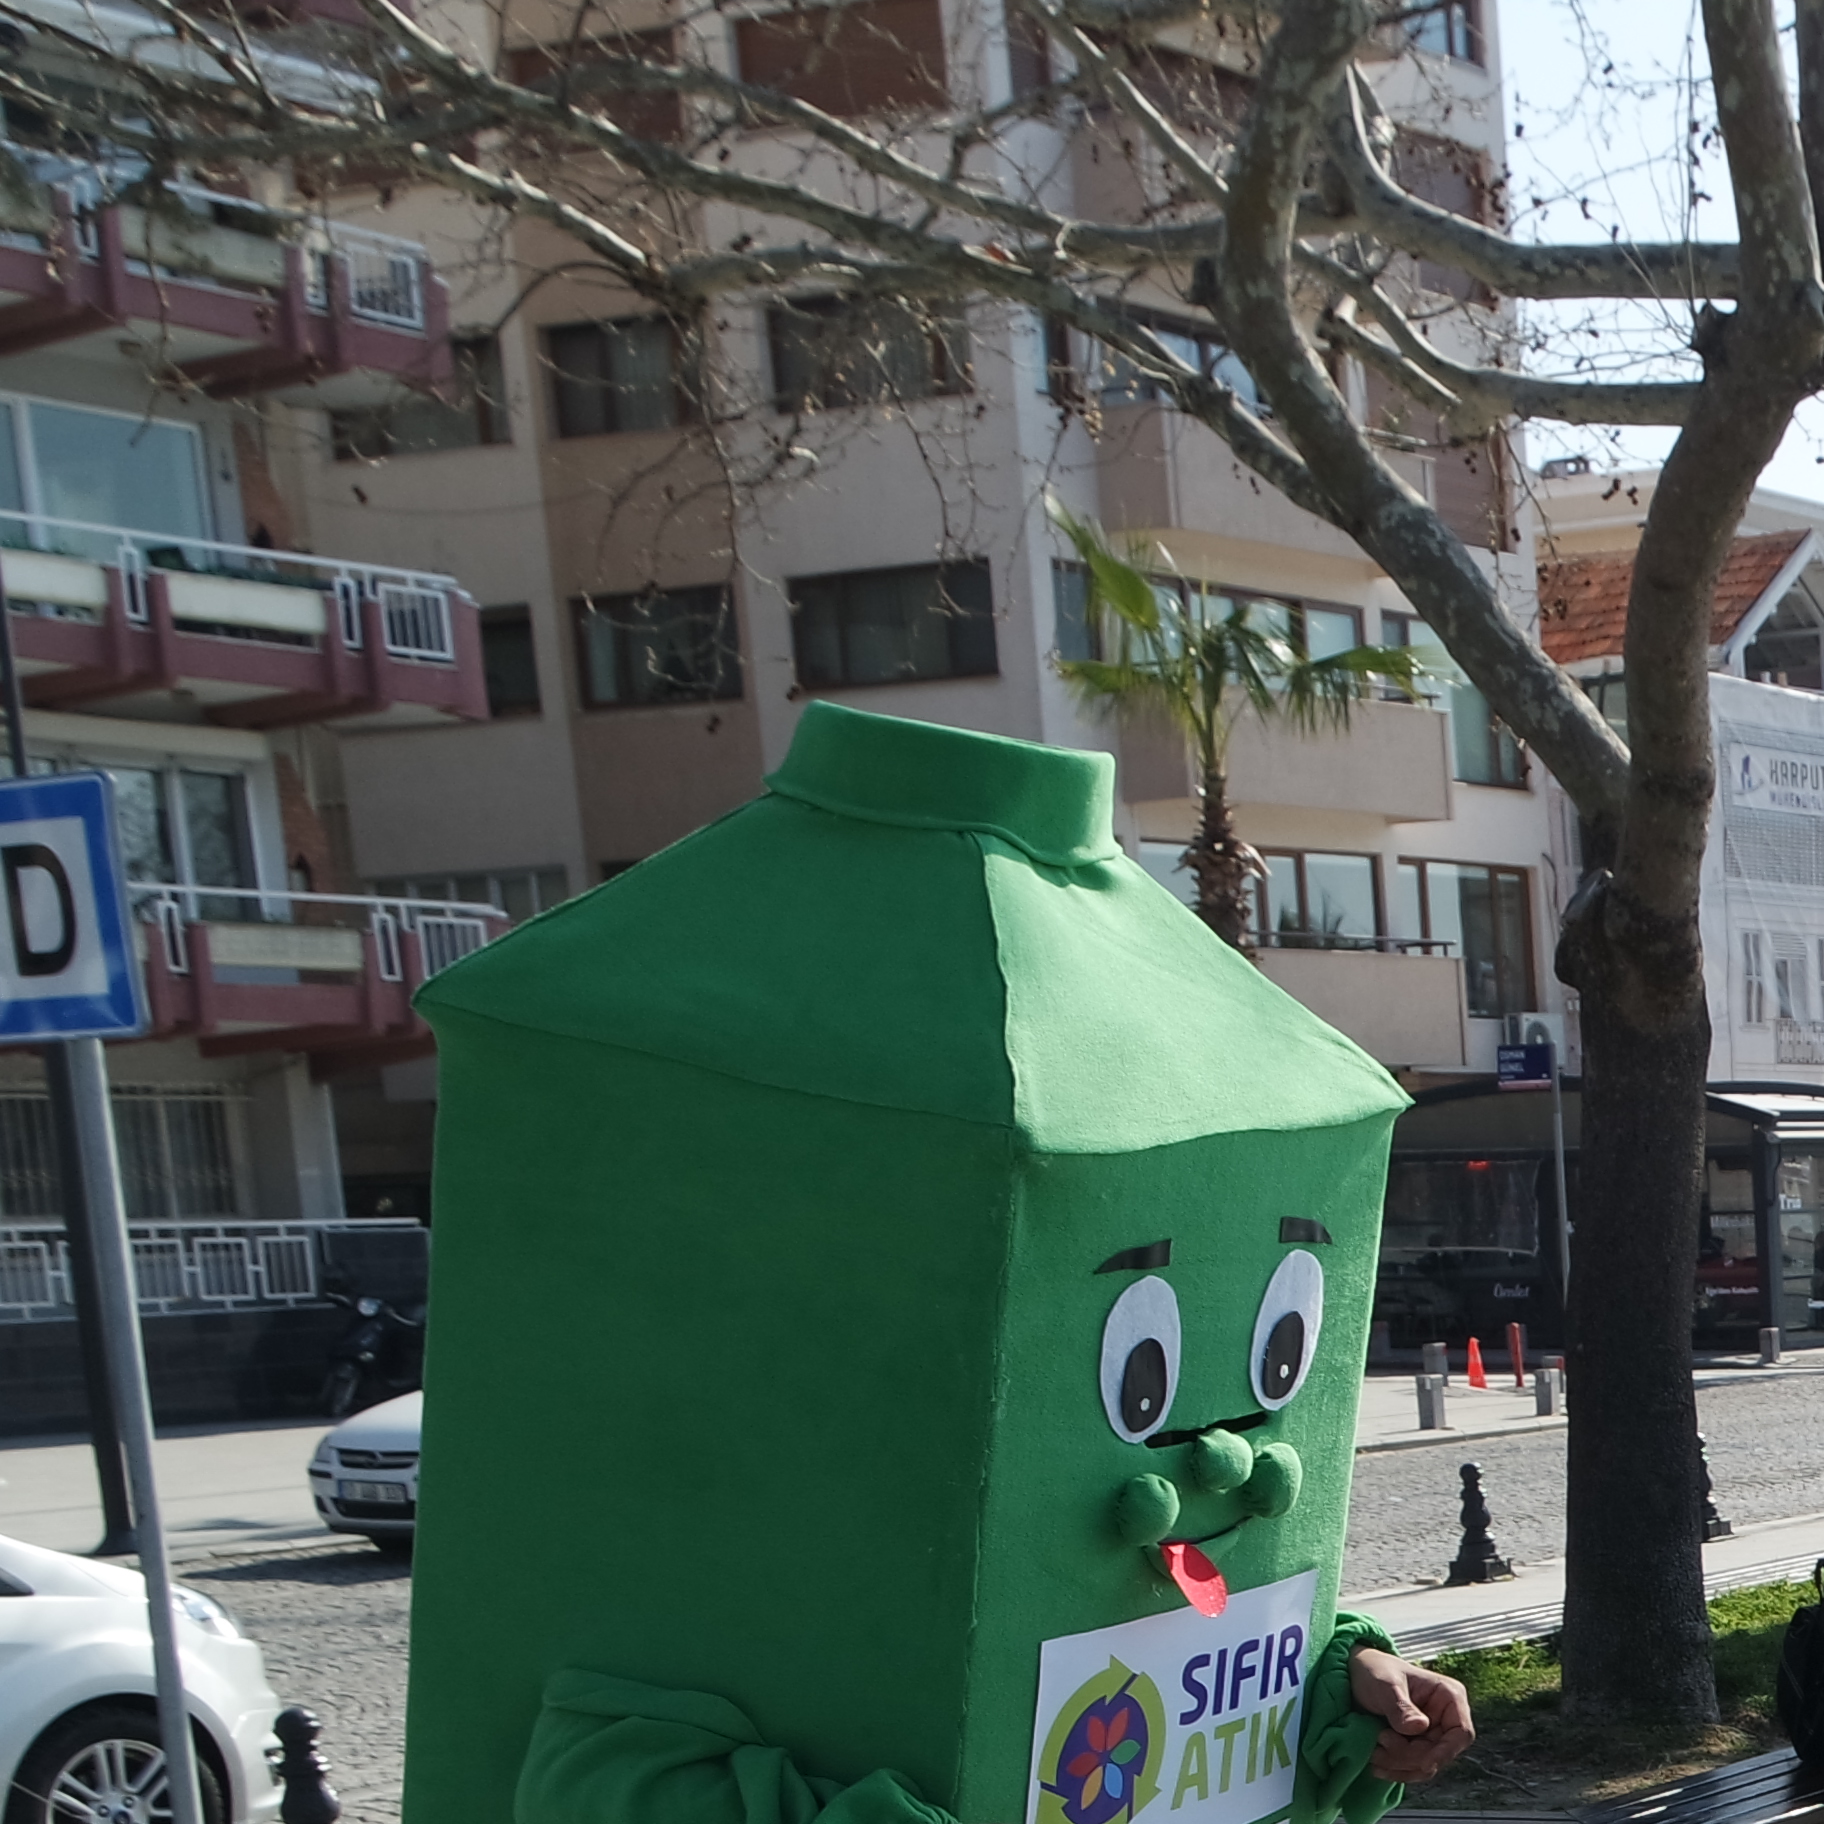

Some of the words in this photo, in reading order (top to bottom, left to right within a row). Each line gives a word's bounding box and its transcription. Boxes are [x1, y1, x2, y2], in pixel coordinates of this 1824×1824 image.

[1, 842, 76, 977] D
[1179, 1624, 1303, 1726] SIFIR
[1170, 1696, 1297, 1811] ATIK
